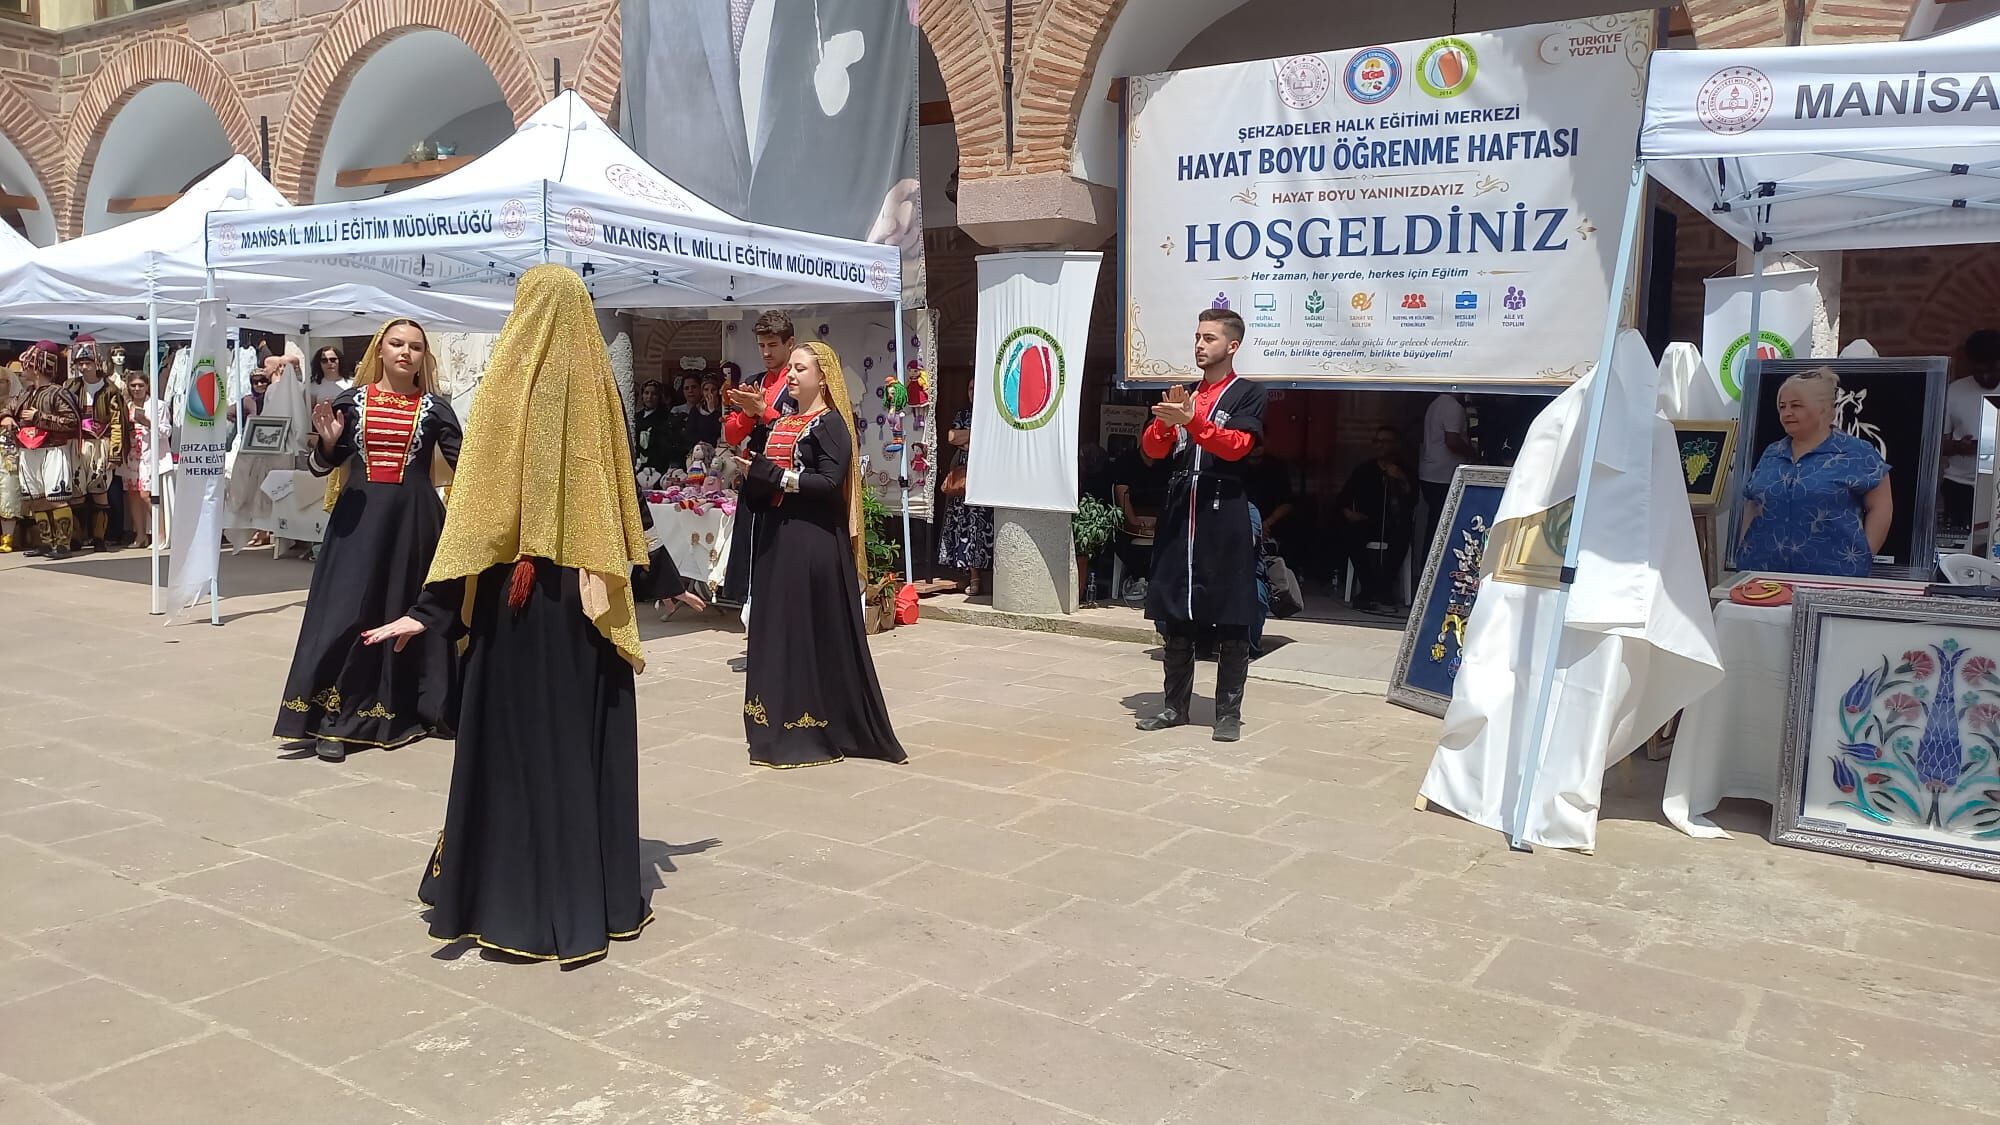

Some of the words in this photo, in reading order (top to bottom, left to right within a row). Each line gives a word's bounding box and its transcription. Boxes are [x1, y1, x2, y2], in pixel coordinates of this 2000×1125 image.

[1794, 70, 2000, 119] MANİSA
[1238, 122, 1331, 143] ŞEHZADELER
[1335, 118, 1375, 134] HALK
[1379, 110, 1440, 130] EĞİTİMİ
[1444, 106, 1520, 126] MERKEZİ
[1178, 150, 1252, 181] HAYAT
[1259, 146, 1325, 174] BOYU
[1333, 136, 1460, 170] ÖĞRENME
[1467, 128, 1579, 162] HAFTASI
[1272, 191, 1314, 204] HAYAT
[1318, 188, 1356, 202] BOYU
[1360, 184, 1464, 200] YANINIZDAYIZ
[241, 226, 287, 248] MANİSA
[290, 224, 300, 245] İL
[304, 220, 338, 244] MİLLİ
[342, 216, 388, 241] EĞİTİM
[392, 210, 493, 238] MÜDÜRLÜĞÜ
[1184, 202, 1569, 268] HOŞGELDİNİZ
[603, 225, 671, 255] MANİSA
[674, 232, 688, 256] İL
[692, 237, 732, 263] MİLLİ
[736, 244, 782, 271] EĞİTİM
[786, 256, 866, 284] MÜDÜRLÜĞÜ
[1251, 272, 1270, 281] Her
[1272, 272, 1310, 282] zaman,
[1312, 271, 1330, 280] her
[1331, 270, 1364, 282] yerde,
[1368, 270, 1404, 279] herkes
[1408, 268, 1428, 280] için
[1432, 268, 1468, 280] Eğitim
[1253, 338, 1278, 348] Hayat
[1280, 338, 1300, 348] boyu
[1302, 338, 1338, 348] öğrenme,
[1340, 338, 1360, 346] daha
[1362, 338, 1384, 348] güçlü
[1400, 338, 1429, 348] gelecek
[1431, 338, 1470, 346] demektir.
[1263, 349, 1287, 358] Gelin,
[1290, 349, 1320, 358] birlikte
[1322, 349, 1367, 359] öğrenelim,
[1370, 350, 1400, 358] birlikte
[1403, 350, 1453, 359] büyüyelim!
